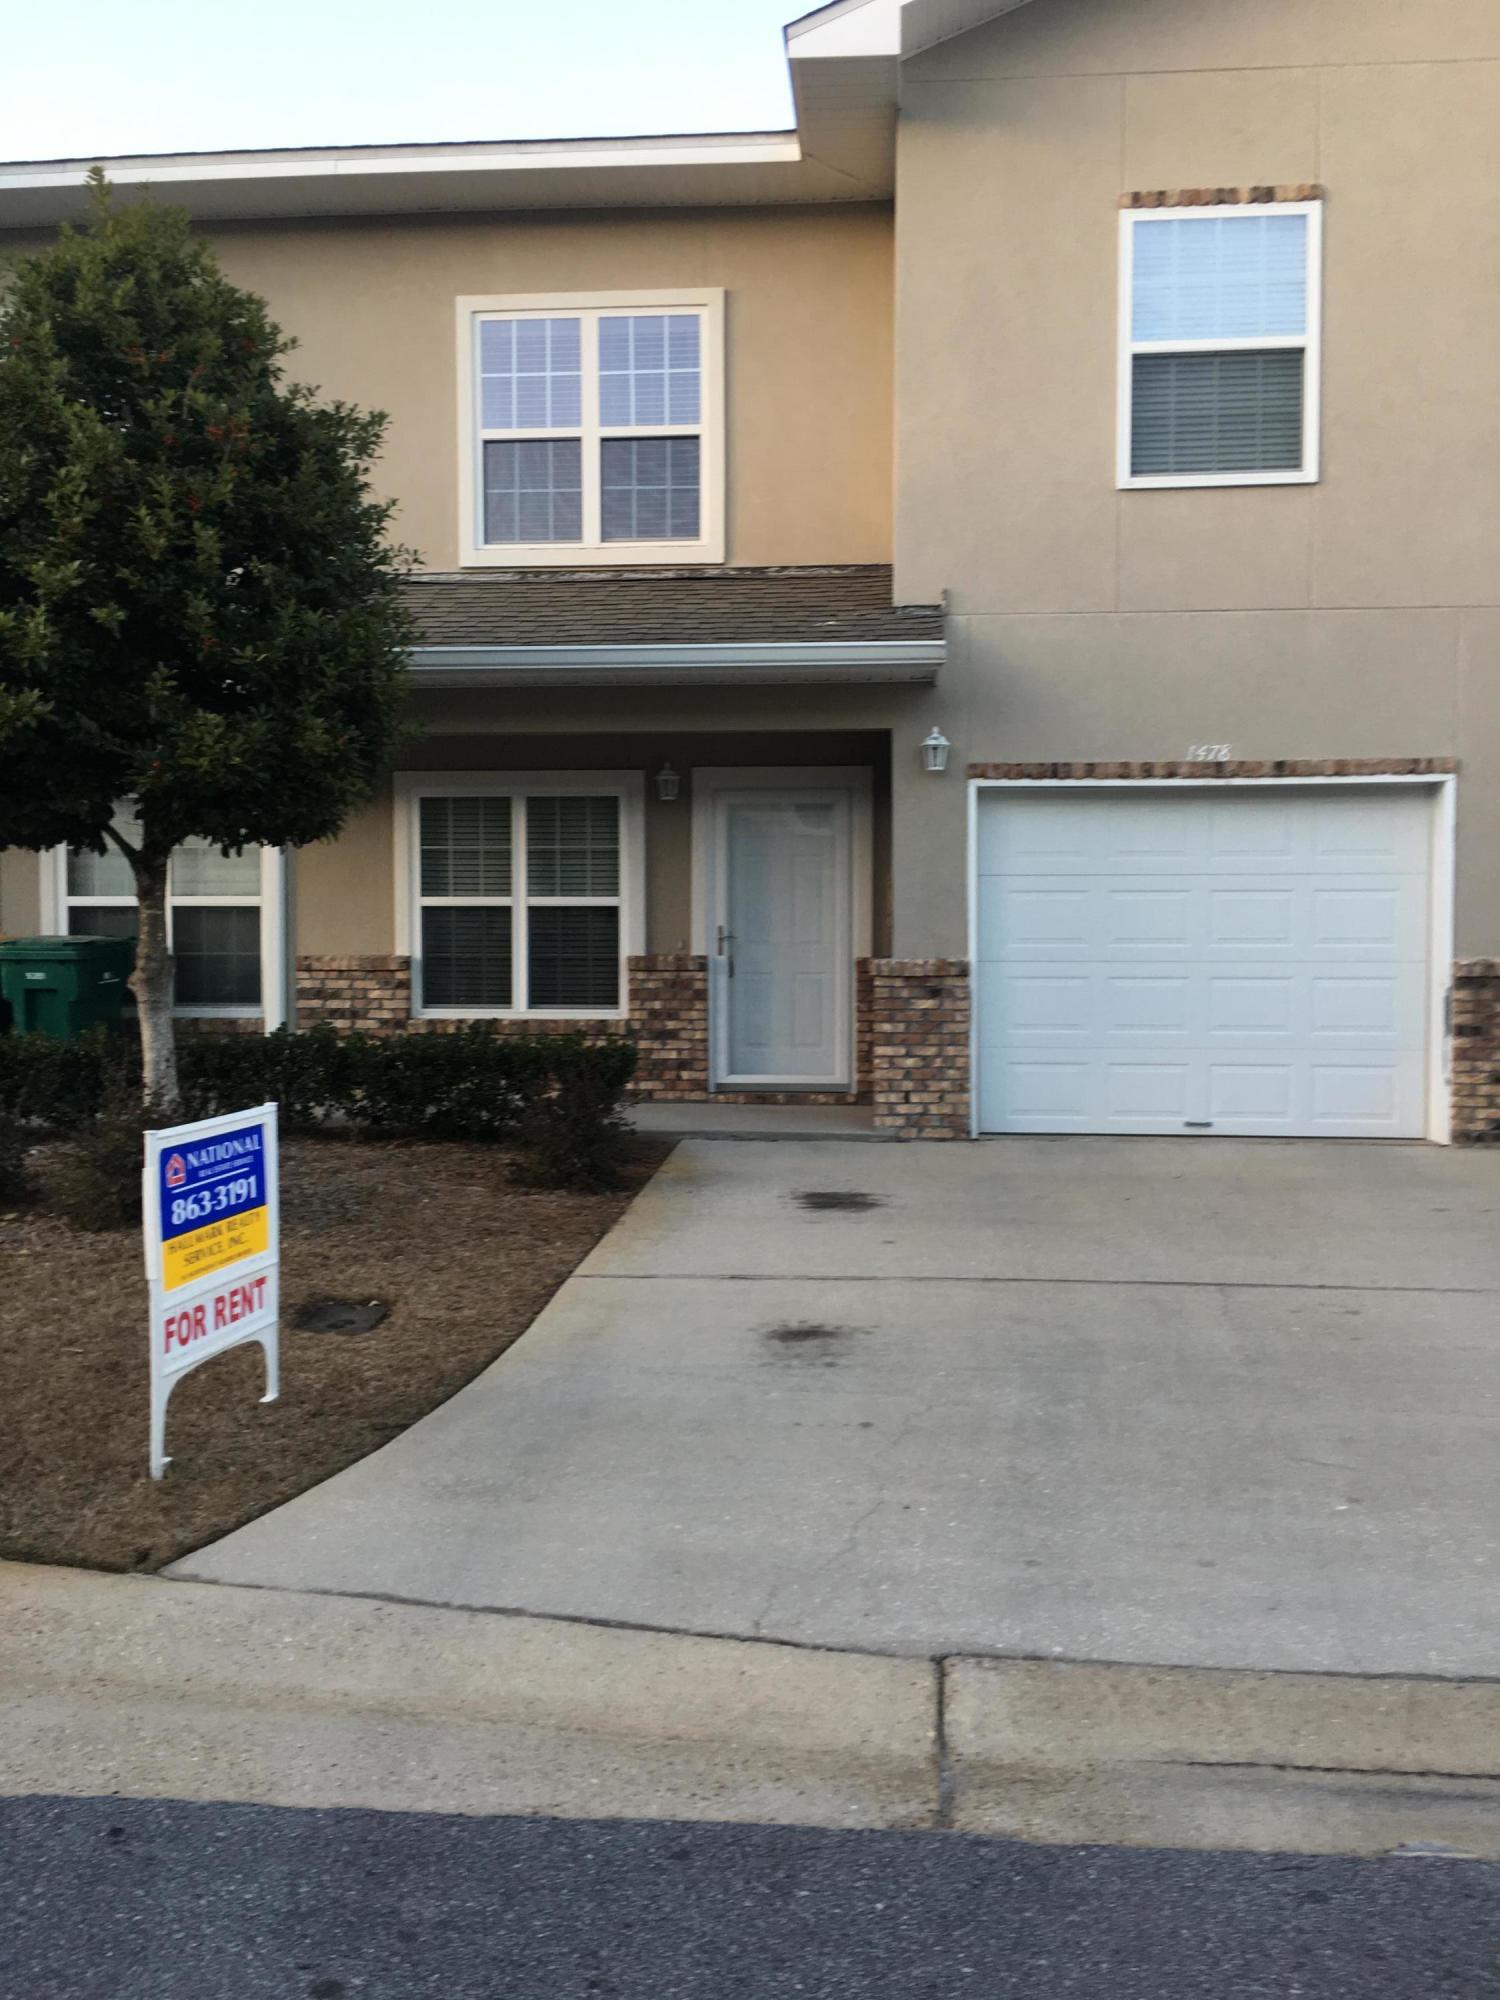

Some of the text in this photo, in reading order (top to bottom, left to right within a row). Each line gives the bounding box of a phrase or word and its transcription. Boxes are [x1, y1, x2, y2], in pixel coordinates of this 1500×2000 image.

[186, 1134, 261, 1169] NATIONAL
[171, 1175, 257, 1224] 863-3191
[164, 1276, 268, 1354] FOR RENT
